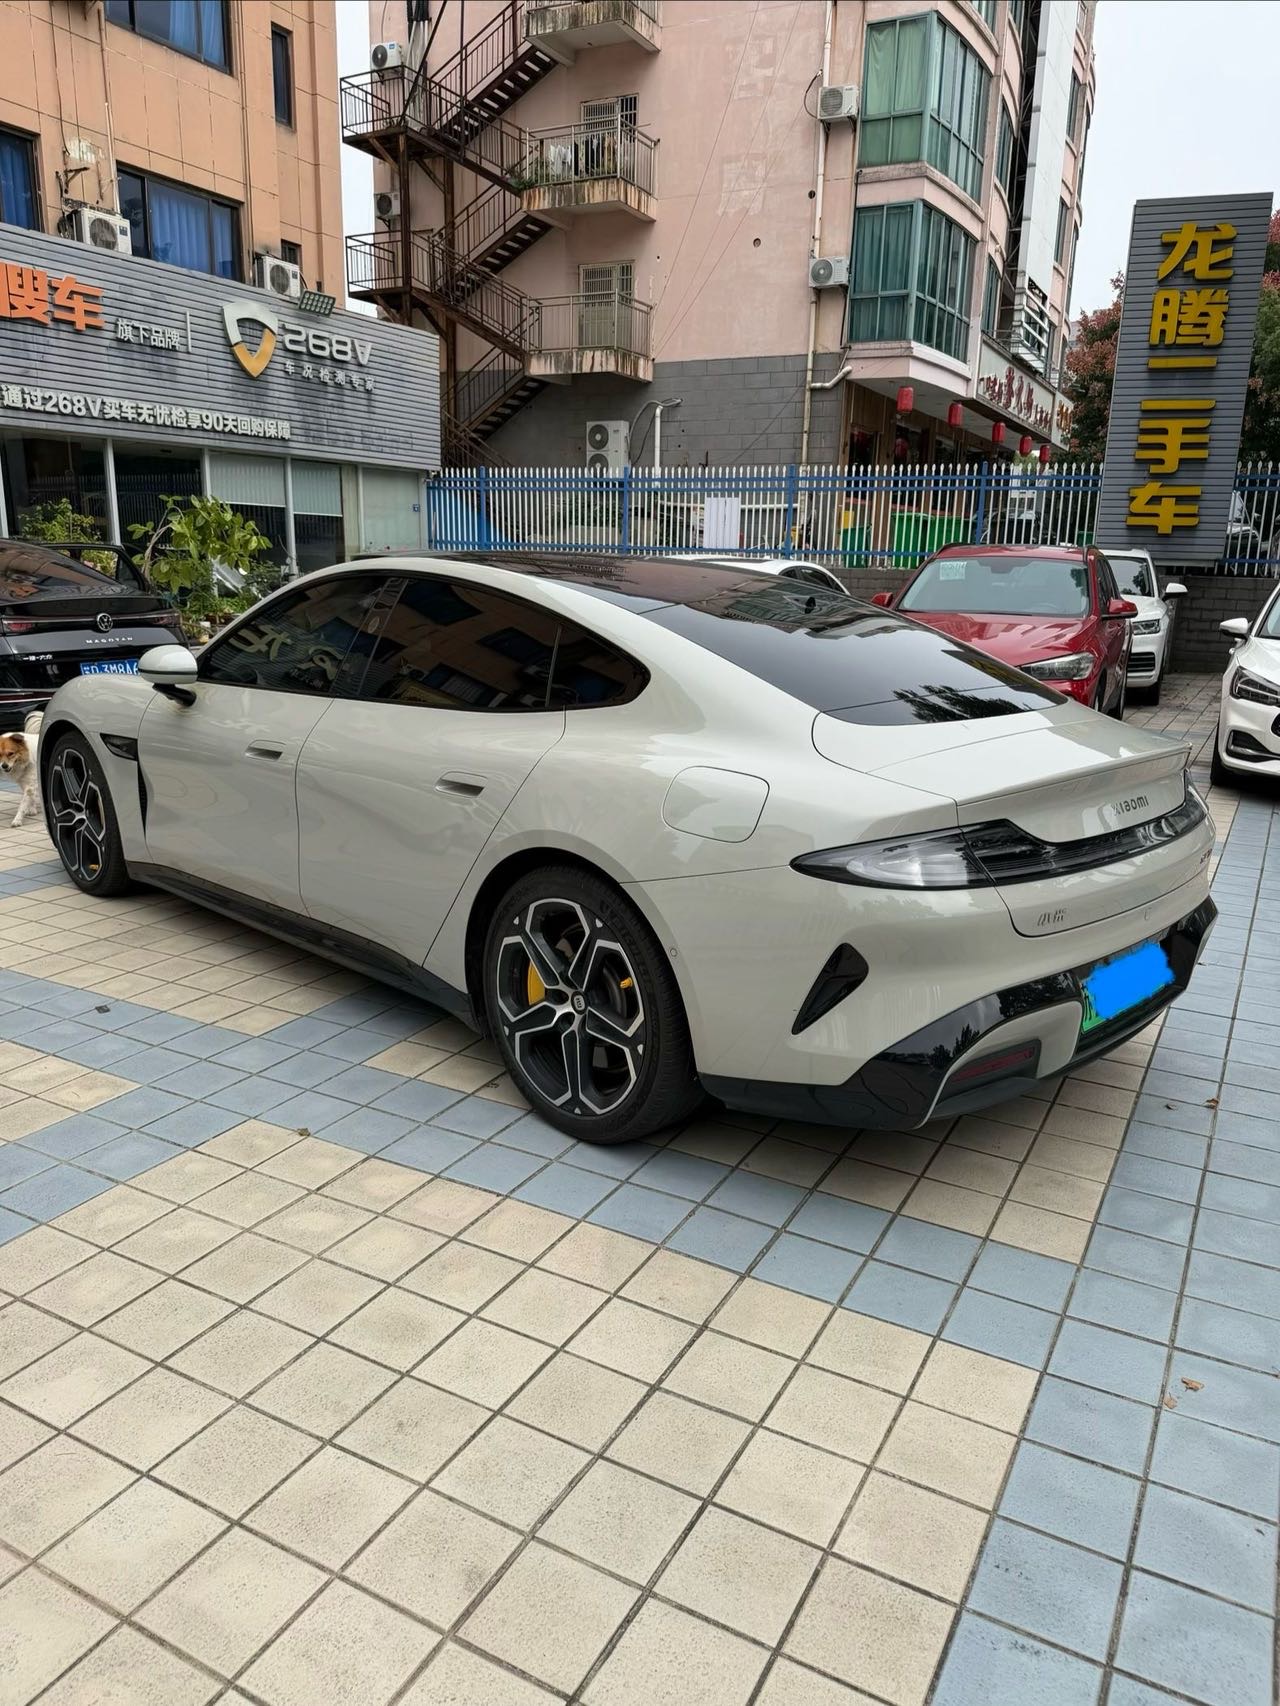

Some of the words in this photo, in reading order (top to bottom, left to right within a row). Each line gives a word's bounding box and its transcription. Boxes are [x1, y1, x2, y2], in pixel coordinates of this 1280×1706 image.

[117, 318, 181, 350] 旗下品牌
[279, 323, 373, 365] 268V
[284, 360, 375, 391] 车况检测专家
[1126, 222, 1238, 535] 龙腾二手车
[1, 384, 291, 440] 通过268V买车无忧检享90天回购保障
[85, 636, 133, 644] MAGOTAN
